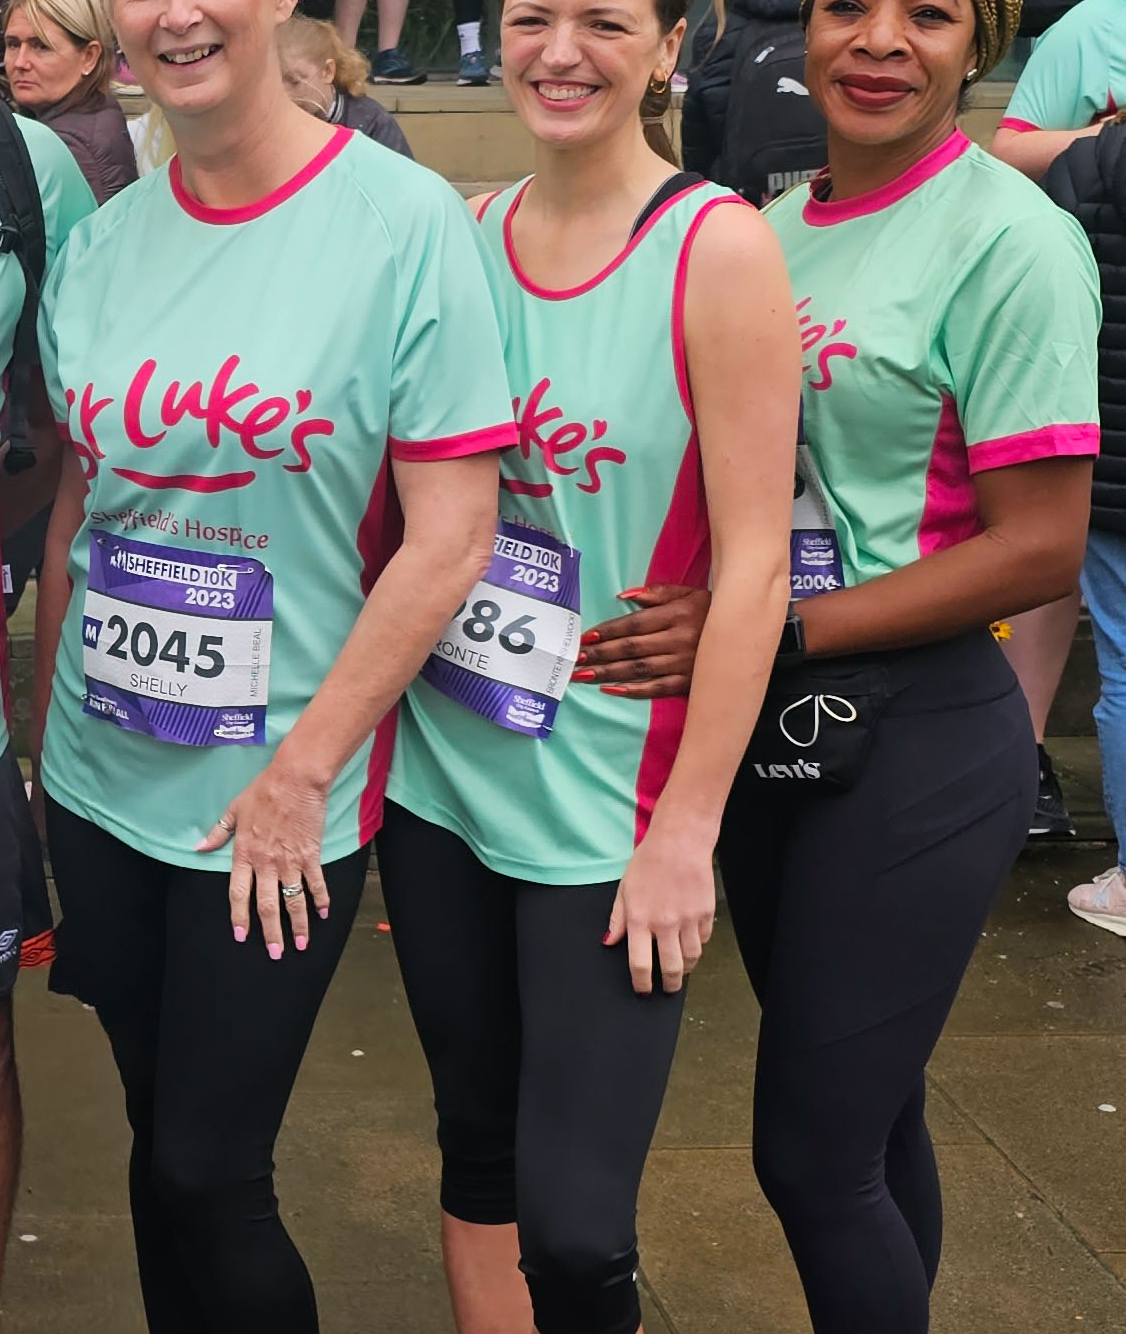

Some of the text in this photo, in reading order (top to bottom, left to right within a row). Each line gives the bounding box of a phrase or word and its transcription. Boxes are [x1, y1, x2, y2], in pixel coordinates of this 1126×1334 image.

[123, 353, 335, 473] Luke's
[512, 377, 627, 494] ke's
[90, 508, 270, 551] Sheffield's Hospice
[128, 554, 235, 588] SHEFFIELD 10K
[494, 536, 561, 571] FIELD 10K
[510, 564, 560, 593] 2023
[184, 587, 235, 610] 2023
[85, 614, 226, 679] M 2045
[451, 599, 538, 655] 86
[249, 628, 263, 698] MICHELLE BEAL
[435, 640, 490, 671] RONTE
[129, 672, 189, 698] SHELLY
